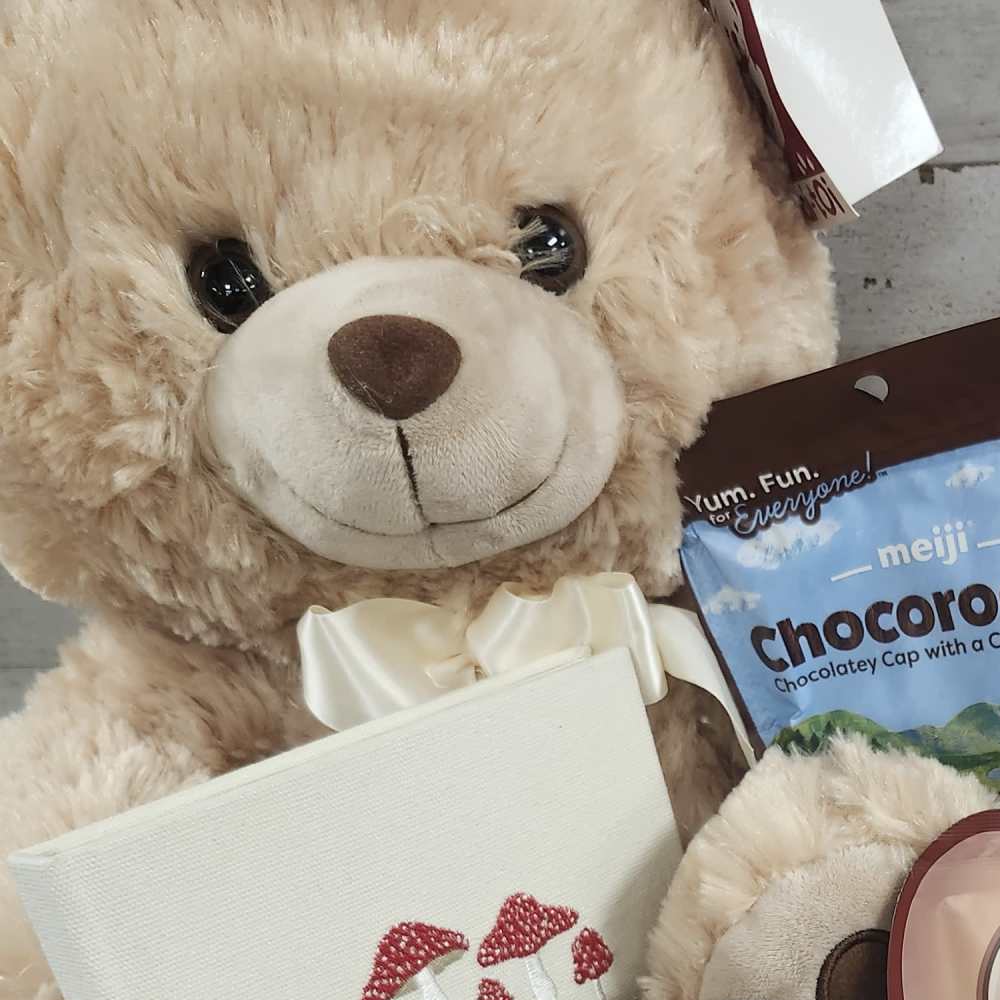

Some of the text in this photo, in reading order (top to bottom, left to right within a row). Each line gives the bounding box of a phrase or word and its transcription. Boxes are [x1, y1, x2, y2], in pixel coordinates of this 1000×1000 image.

[684, 465, 820, 513] Yum. Fun.
[708, 450, 873, 534] for Everyone!
[878, 520, 968, 568] meiji
[774, 655, 878, 694] Chocolatey
[882, 648, 920, 668] Cap
[924, 637, 967, 660] with
[972, 640, 985, 653] a
